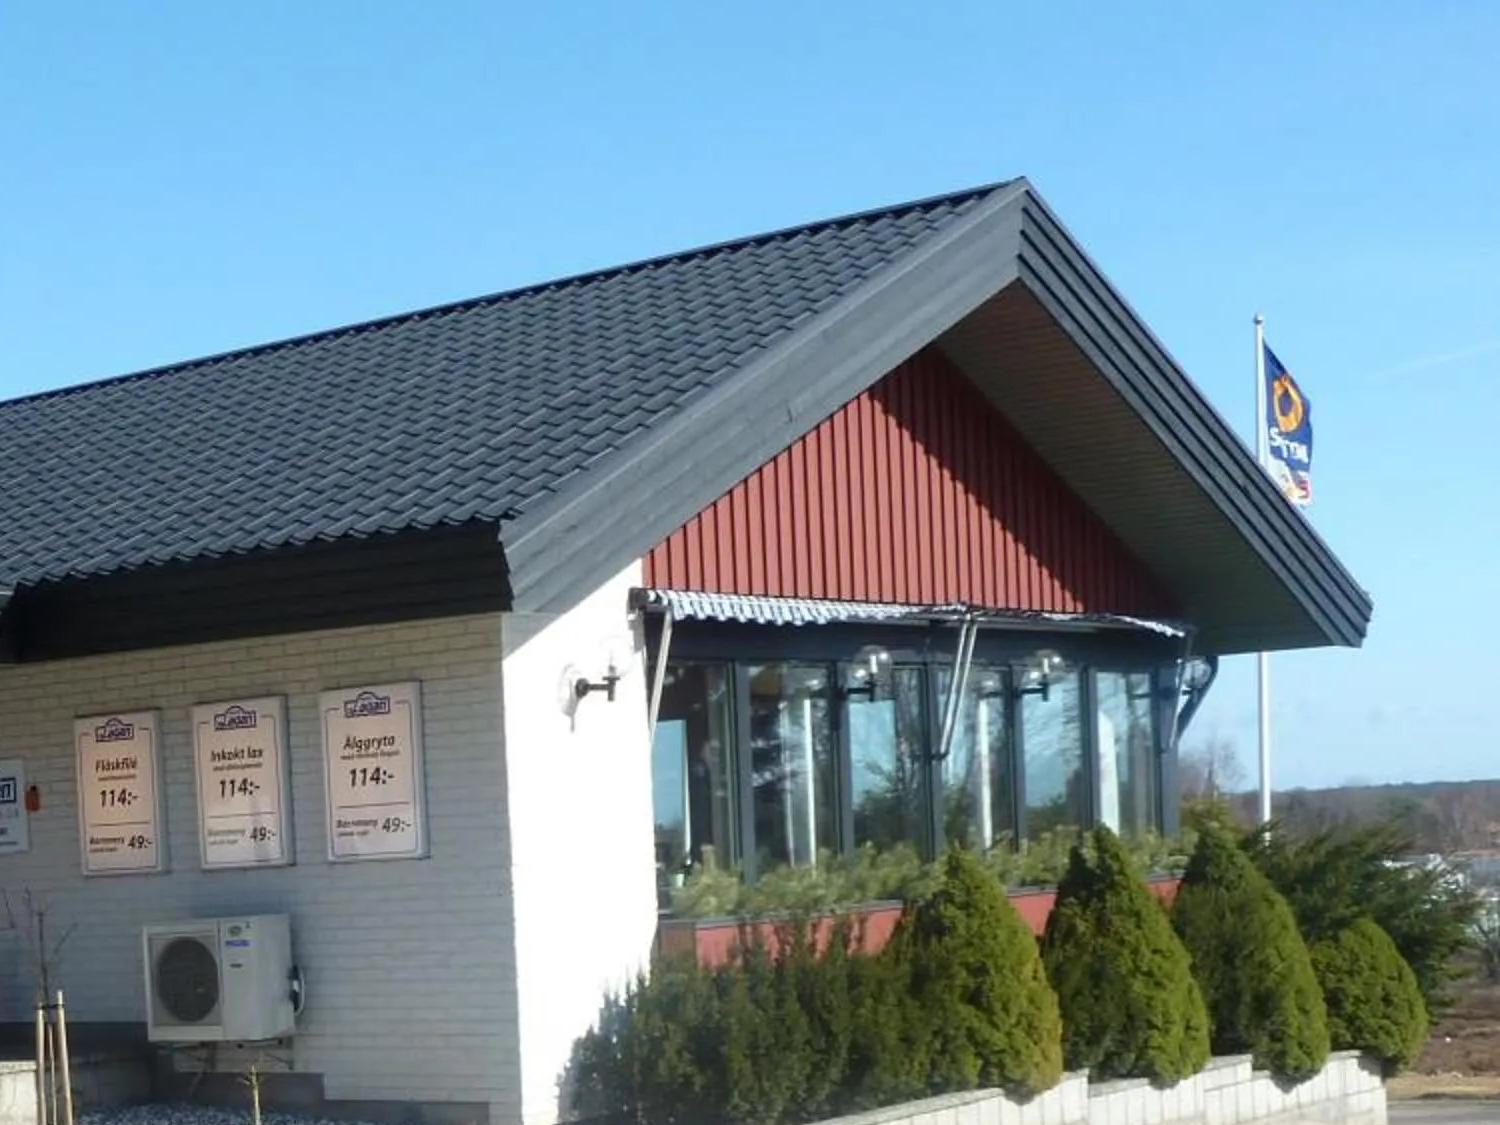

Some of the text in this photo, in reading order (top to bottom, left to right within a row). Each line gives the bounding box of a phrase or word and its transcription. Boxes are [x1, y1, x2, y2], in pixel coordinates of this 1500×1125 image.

[349, 766, 395, 787] 114:-
[100, 788, 138, 808] 114:-
[219, 778, 260, 799] 114:-
